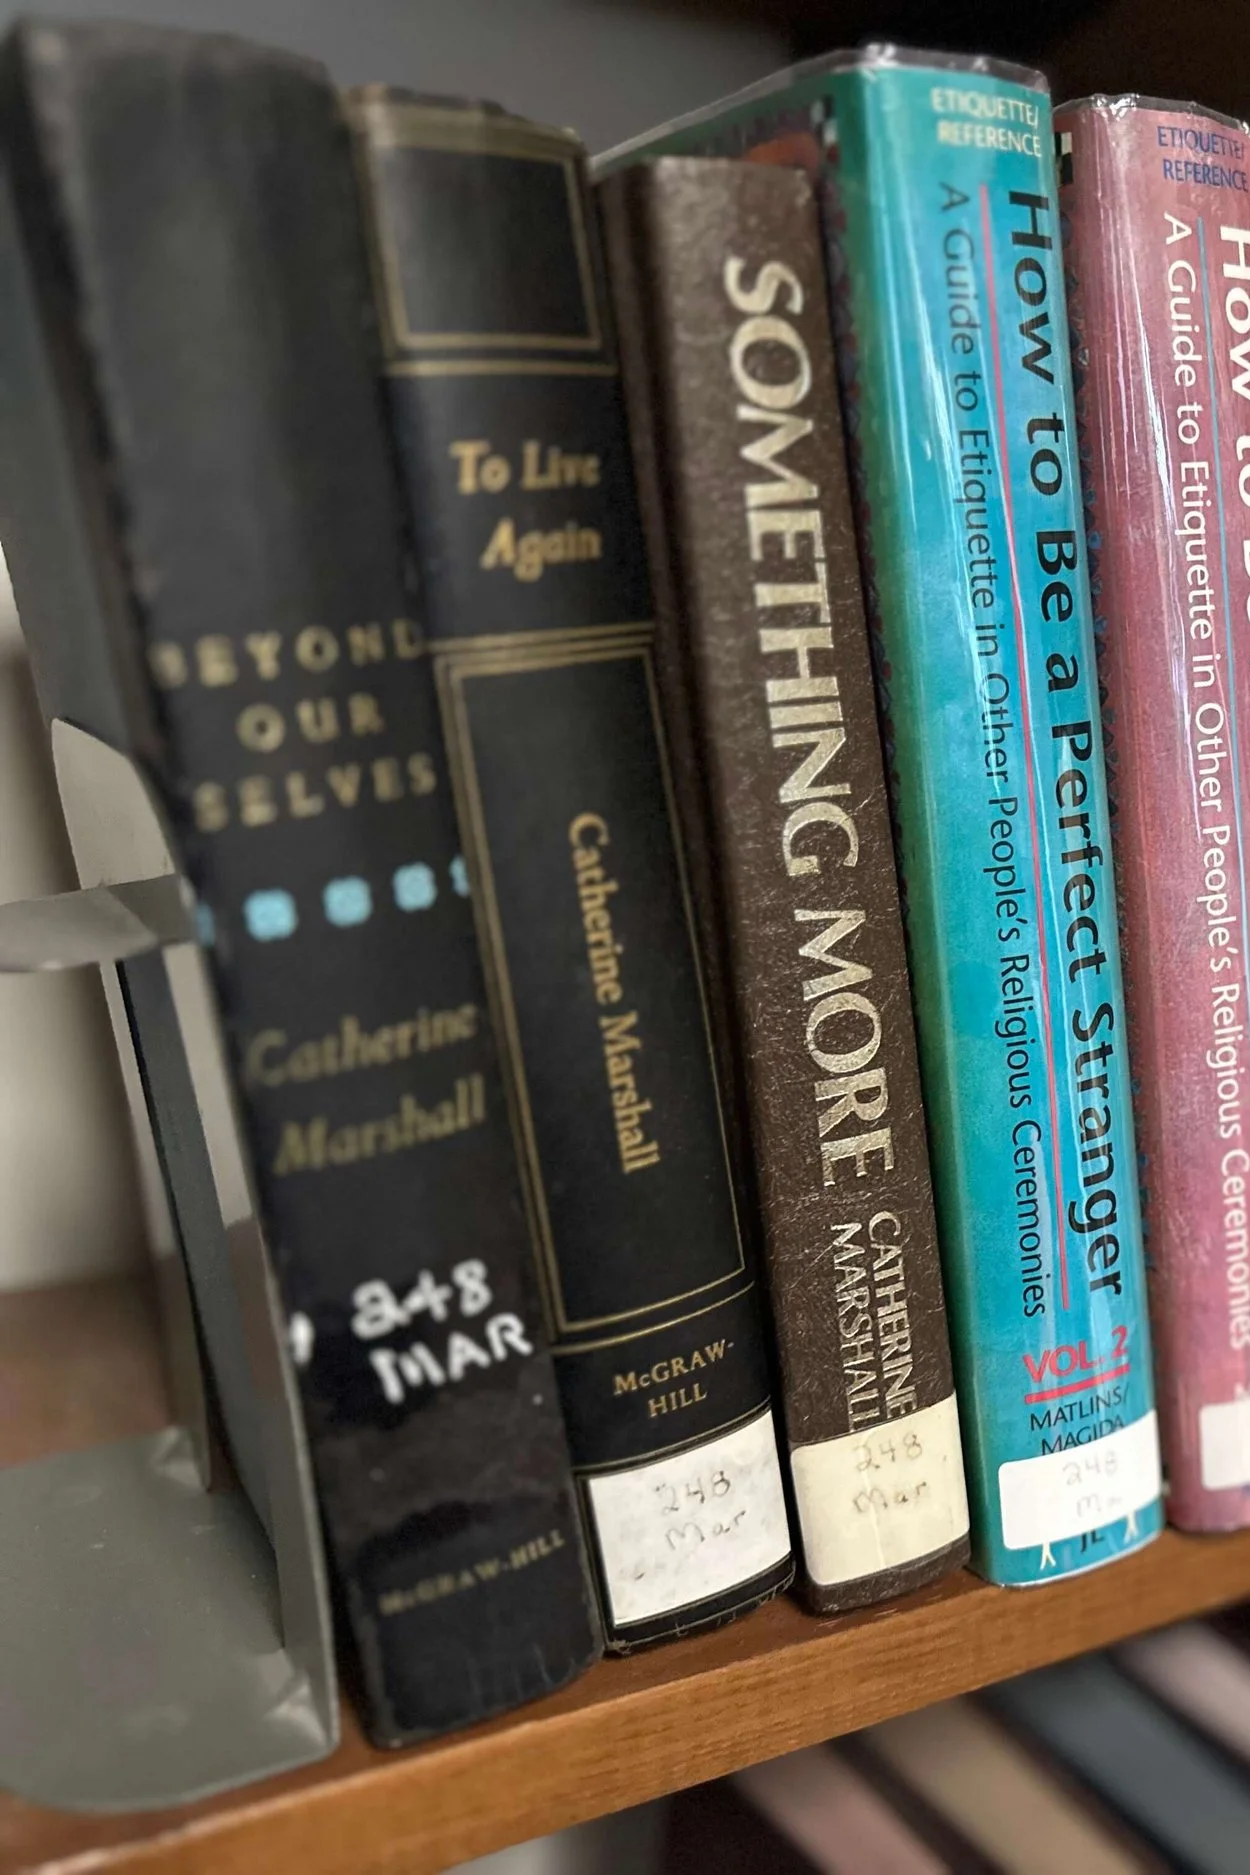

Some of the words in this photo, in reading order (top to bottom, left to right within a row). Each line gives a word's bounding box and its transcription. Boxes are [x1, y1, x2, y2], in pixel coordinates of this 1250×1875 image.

[937, 119, 1042, 158] REFERENCE
[1163, 159, 1248, 193] REFERENCE
[940, 181, 971, 213] A
[1163, 212, 1192, 244] A
[943, 228, 981, 356] Guide
[1008, 190, 1055, 386] How
[1167, 260, 1202, 388] Guide
[954, 368, 982, 413] to
[1176, 401, 1203, 446] to
[449, 440, 511, 495] To
[519, 440, 600, 491] Live
[1025, 412, 1065, 496] to
[480, 517, 602, 582] Again
[954, 427, 998, 610] Etiquette
[1174, 460, 1214, 642] Etiquette
[1035, 530, 1079, 623] Be
[149, 619, 426, 687] BEYOND
[974, 622, 1006, 658] in
[1045, 652, 1079, 694] a
[1192, 653, 1221, 689] in
[236, 693, 384, 752] OUR
[724, 255, 860, 878] SOMETHING
[794, 908, 895, 1187] MORE
[979, 671, 1014, 785] Other
[1195, 701, 1228, 813] Other
[193, 753, 437, 831] SELVES
[983, 796, 1030, 942] People's
[1050, 719, 1109, 985] Perfect
[1197, 825, 1239, 971] People's
[568, 811, 624, 1007] Catherine
[600, 1010, 661, 1175] Marshall
[994, 953, 1033, 1109] Religious
[249, 1003, 478, 1087] Catherine
[1206, 981, 1244, 1139] Religious
[272, 1072, 486, 1178] Marshall
[1068, 1001, 1122, 1299] Stranger
[1011, 1119, 1053, 1319] Ceremonies
[350, 1257, 492, 1340] 248
[831, 1222, 881, 1434] MARSHALL
[868, 1210, 917, 1419] CATHERINE
[369, 1312, 533, 1405] MAR
[613, 1339, 735, 1396] McGRAW-
[1111, 1325, 1128, 1360] 2
[648, 1383, 708, 1418] HILL
[1030, 1383, 1130, 1432] MATLINS/
[655, 1470, 731, 1516] 248
[852, 1433, 923, 1472] 248
[665, 1510, 746, 1550] Mar
